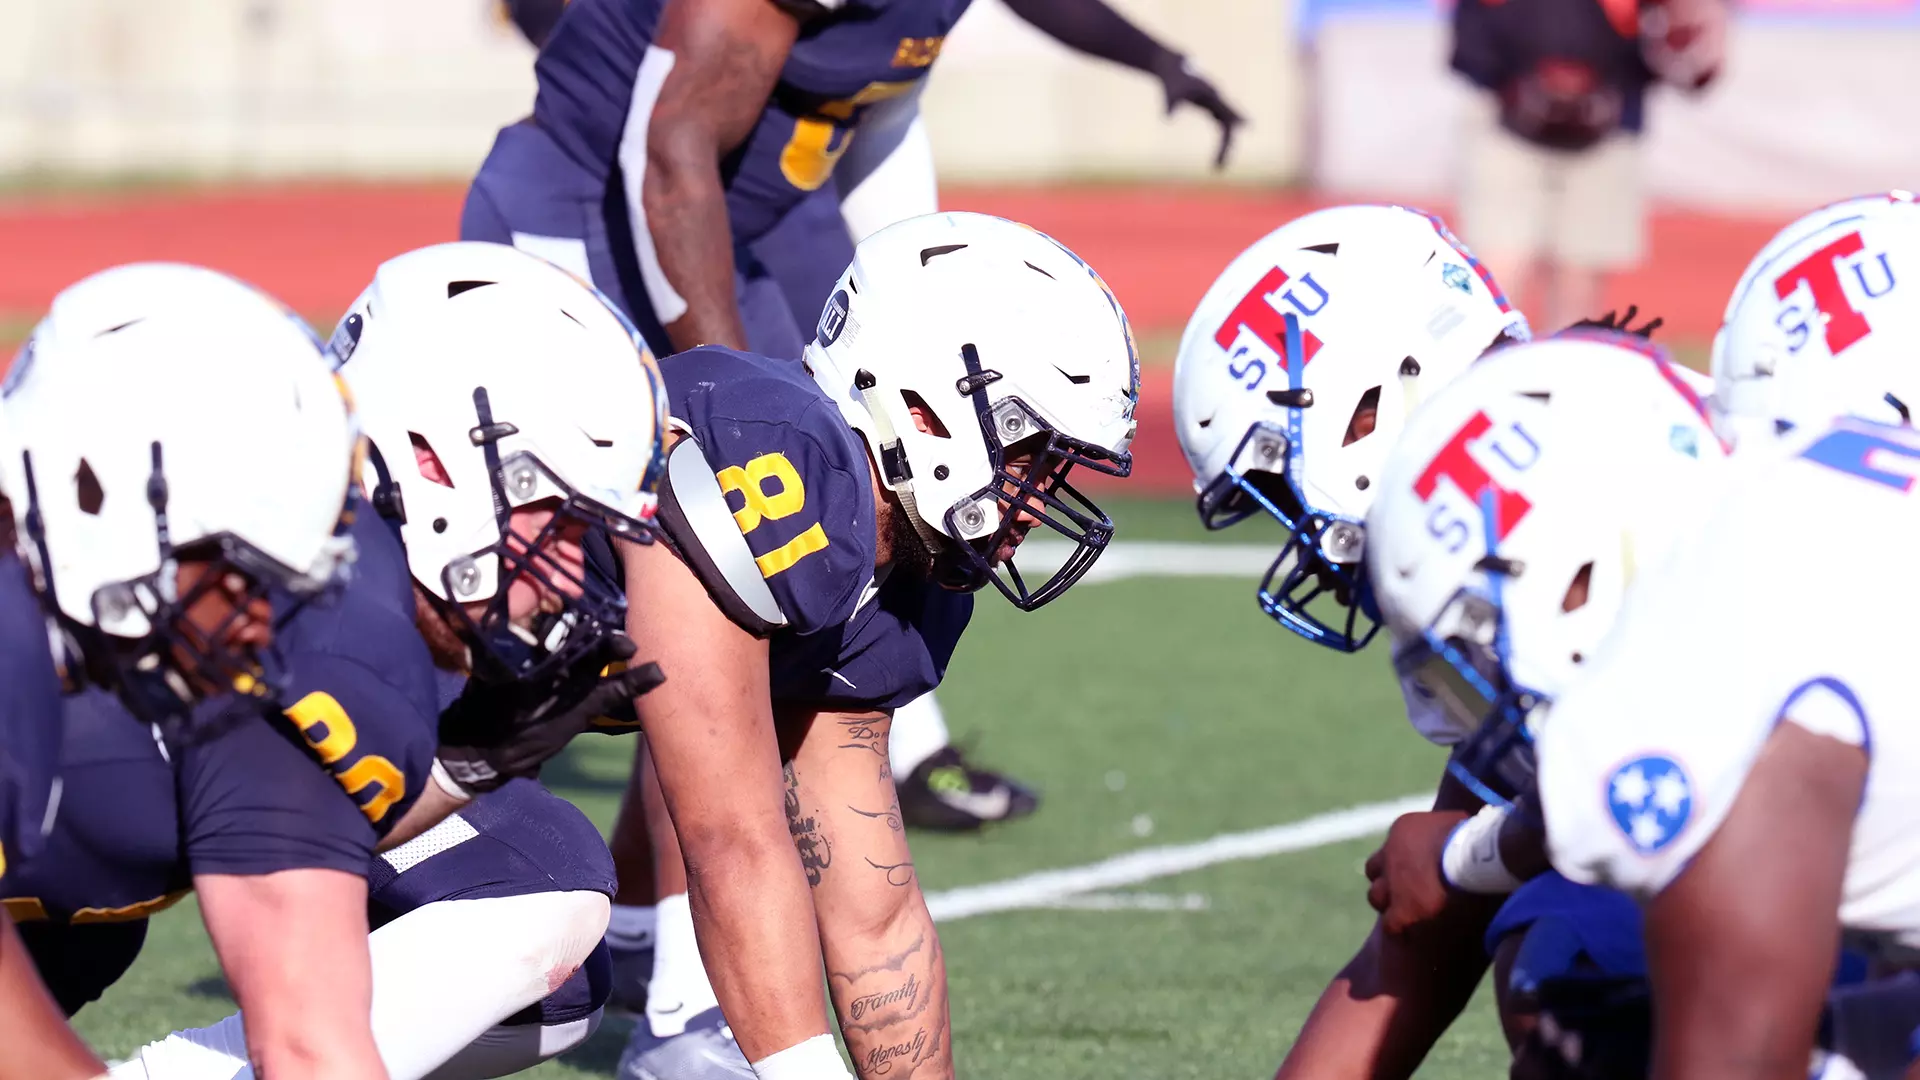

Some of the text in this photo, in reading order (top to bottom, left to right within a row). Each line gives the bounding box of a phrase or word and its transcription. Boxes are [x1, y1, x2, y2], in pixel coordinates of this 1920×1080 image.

[716, 452, 830, 579] 81
[851, 973, 921, 1020] Family
[861, 1026, 928, 1075] Honesty
